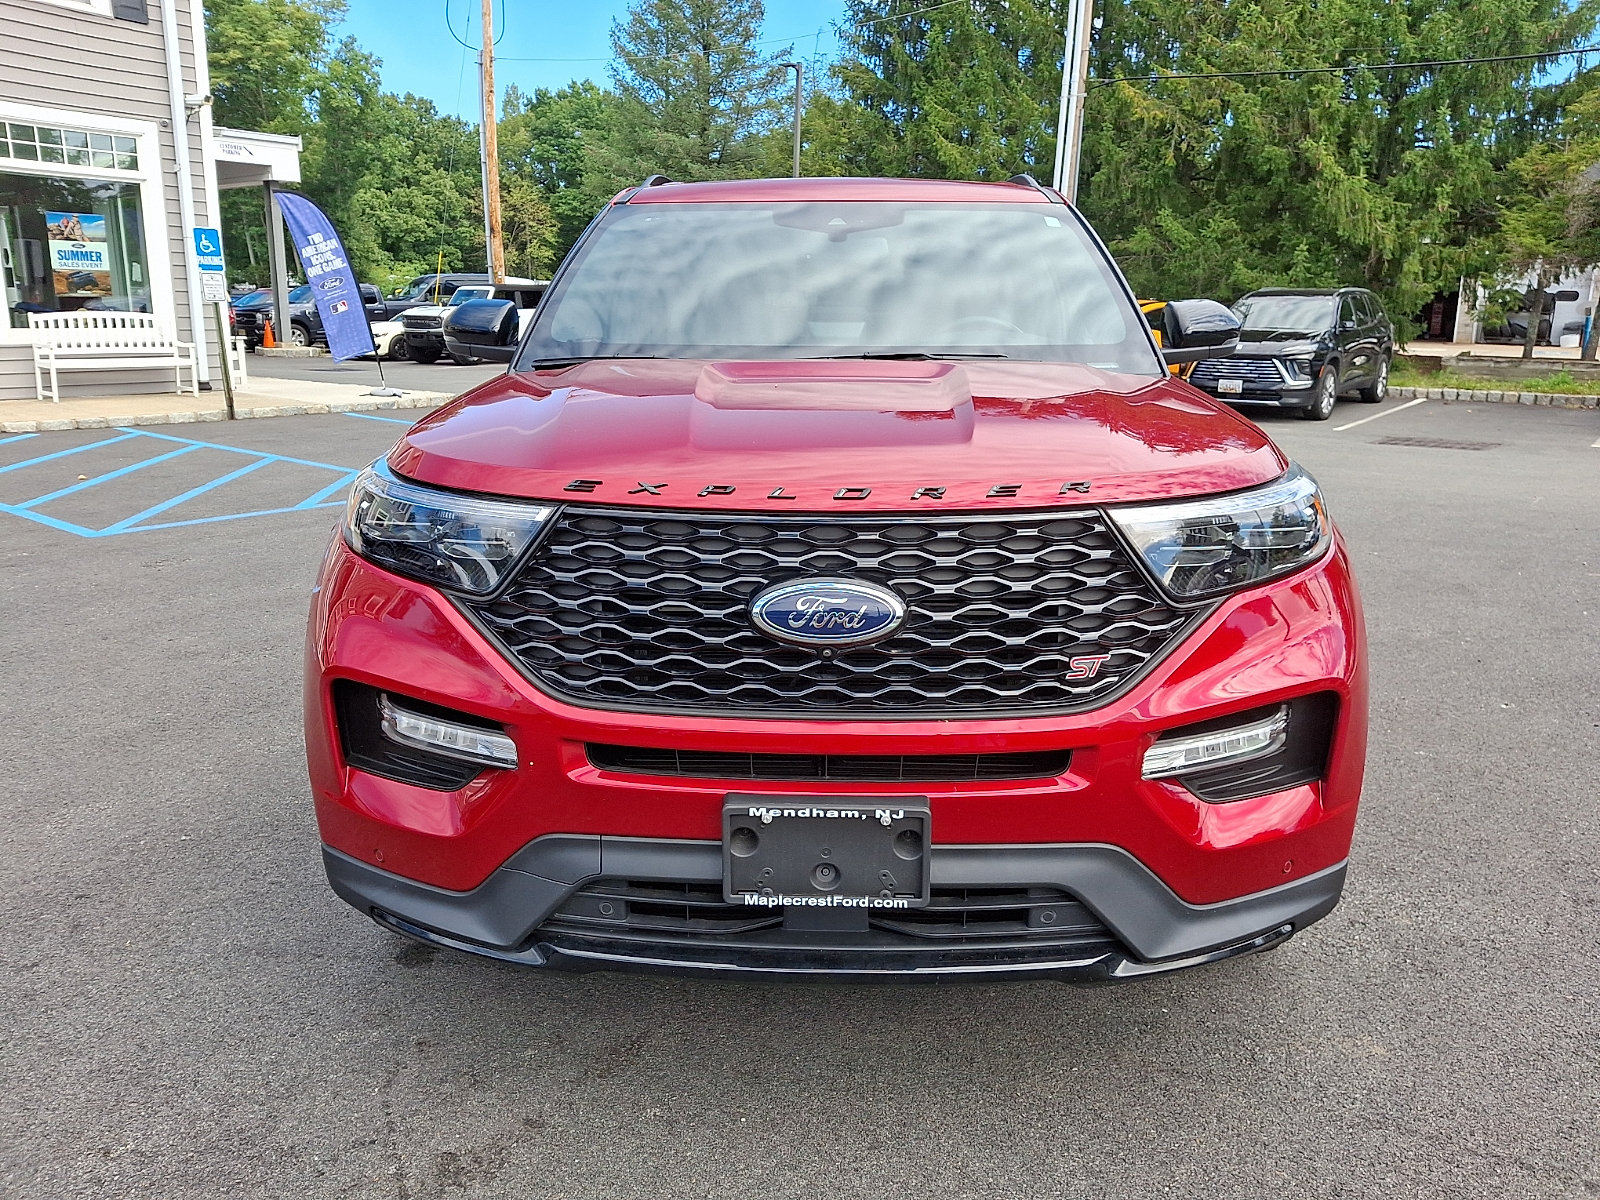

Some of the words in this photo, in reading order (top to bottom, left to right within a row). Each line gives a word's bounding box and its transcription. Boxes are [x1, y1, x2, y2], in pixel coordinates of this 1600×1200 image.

[306, 232, 324, 245] TWO
[57, 249, 103, 262] SUMMER
[301, 238, 339, 258] AMERICAN
[197, 255, 223, 265] PARKING
[307, 263, 324, 278] ONE
[321, 257, 347, 273] GAME.
[323, 278, 340, 290] Ford
[563, 479, 1094, 501] EXPLORER
[788, 595, 868, 629] Ford
[1065, 654, 1111, 680] ST
[748, 807, 867, 821] Mendham,
[875, 808, 905, 821] NJ
[744, 894, 908, 909] MaplecrestFord.com
